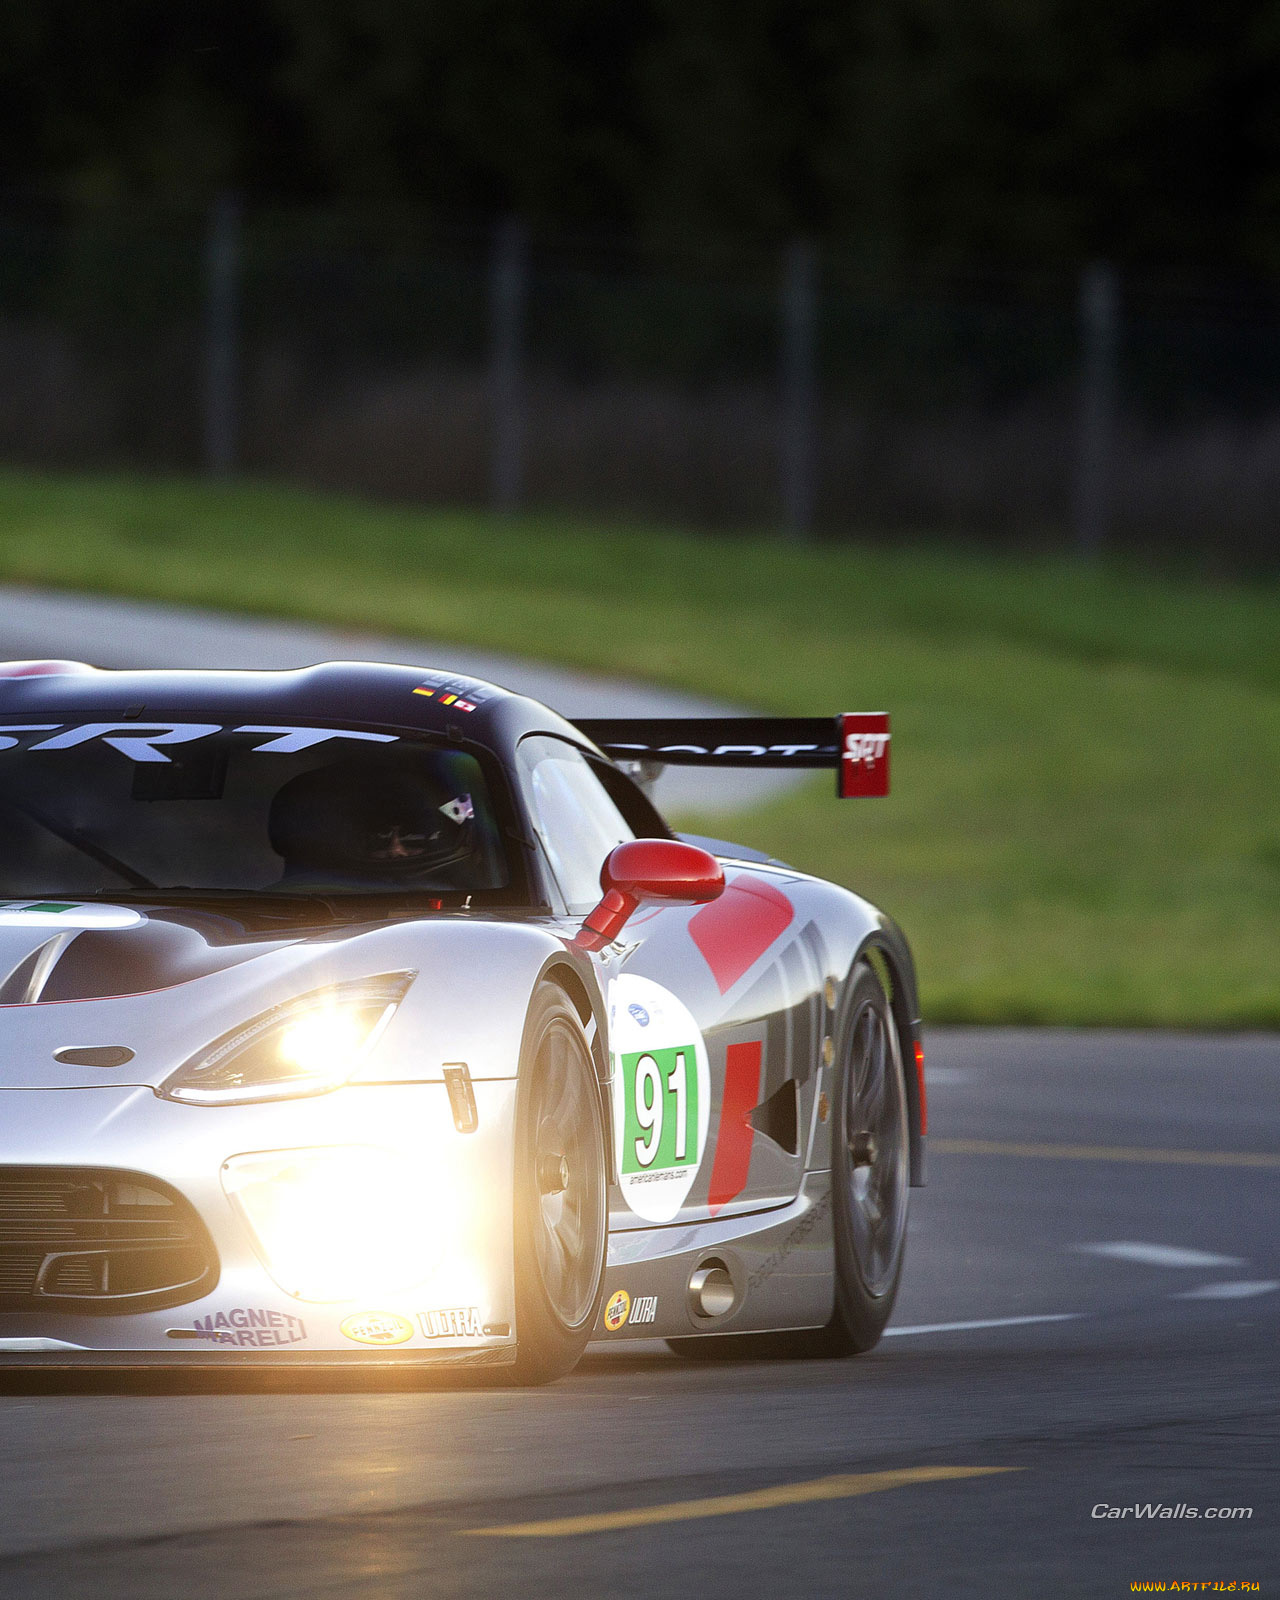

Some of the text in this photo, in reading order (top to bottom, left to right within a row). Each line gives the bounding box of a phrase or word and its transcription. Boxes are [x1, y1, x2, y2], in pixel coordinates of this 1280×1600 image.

[842, 733, 891, 759] SRT
[634, 1052, 687, 1168] 91
[193, 1308, 307, 1332] MAGNETI
[416, 1307, 483, 1339] ULTRA
[628, 1296, 658, 1324] ULTRA
